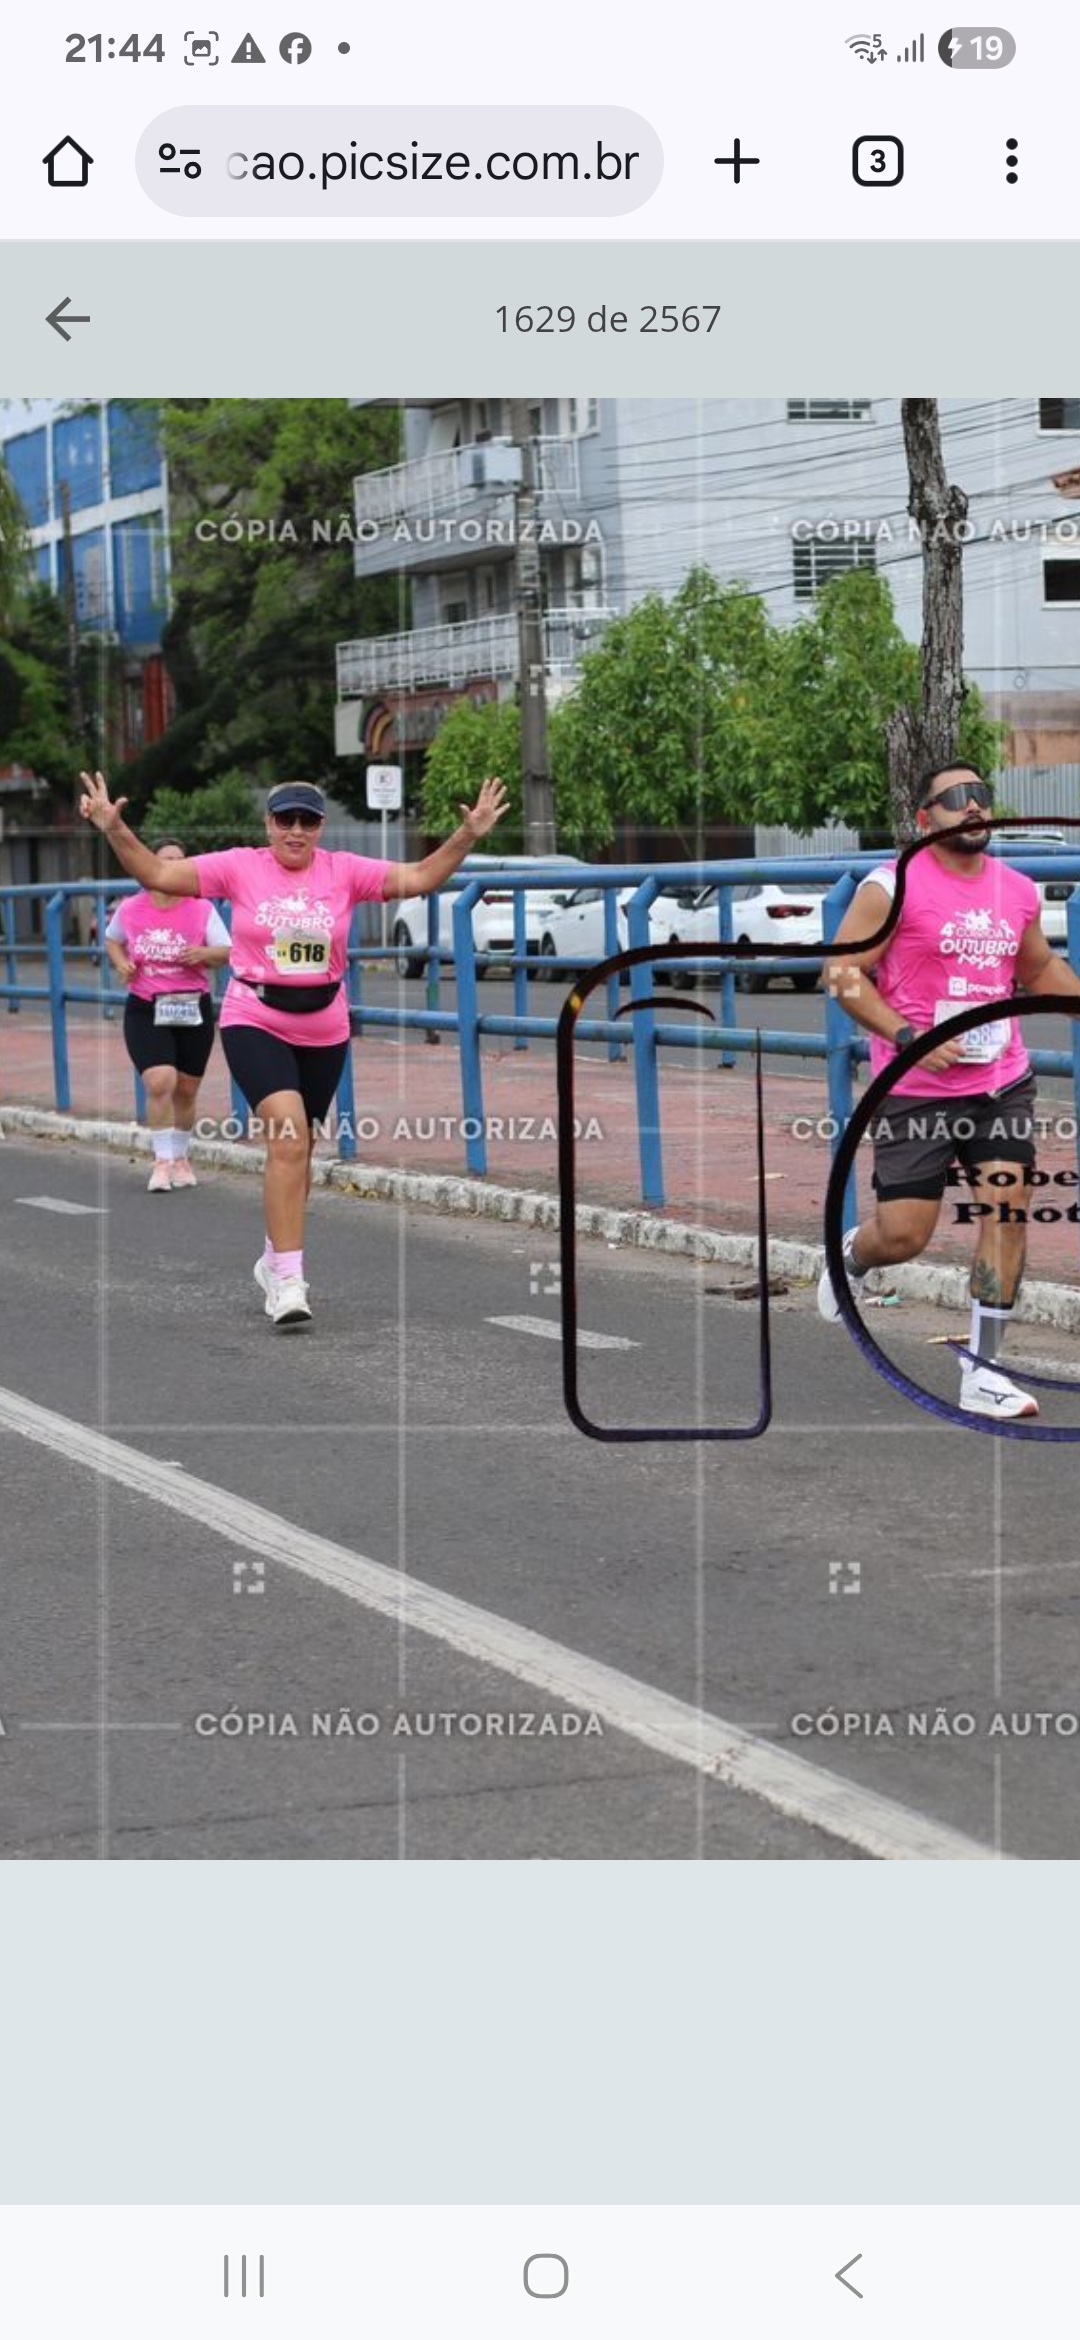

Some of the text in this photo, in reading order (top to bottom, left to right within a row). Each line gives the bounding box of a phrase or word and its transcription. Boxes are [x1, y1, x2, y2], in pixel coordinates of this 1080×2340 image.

[65, 33, 166, 63] 21:44
[969, 35, 1004, 61] 19
[226, 140, 640, 190] cao.picsize.com.br
[869, 148, 887, 174] 3
[496, 305, 721, 333] 1629 de 2567
[254, 912, 336, 930] OUTUBRO
[134, 943, 183, 957] OUTUBR
[289, 942, 326, 964] 618
[940, 938, 1020, 956] OUTUBRO
